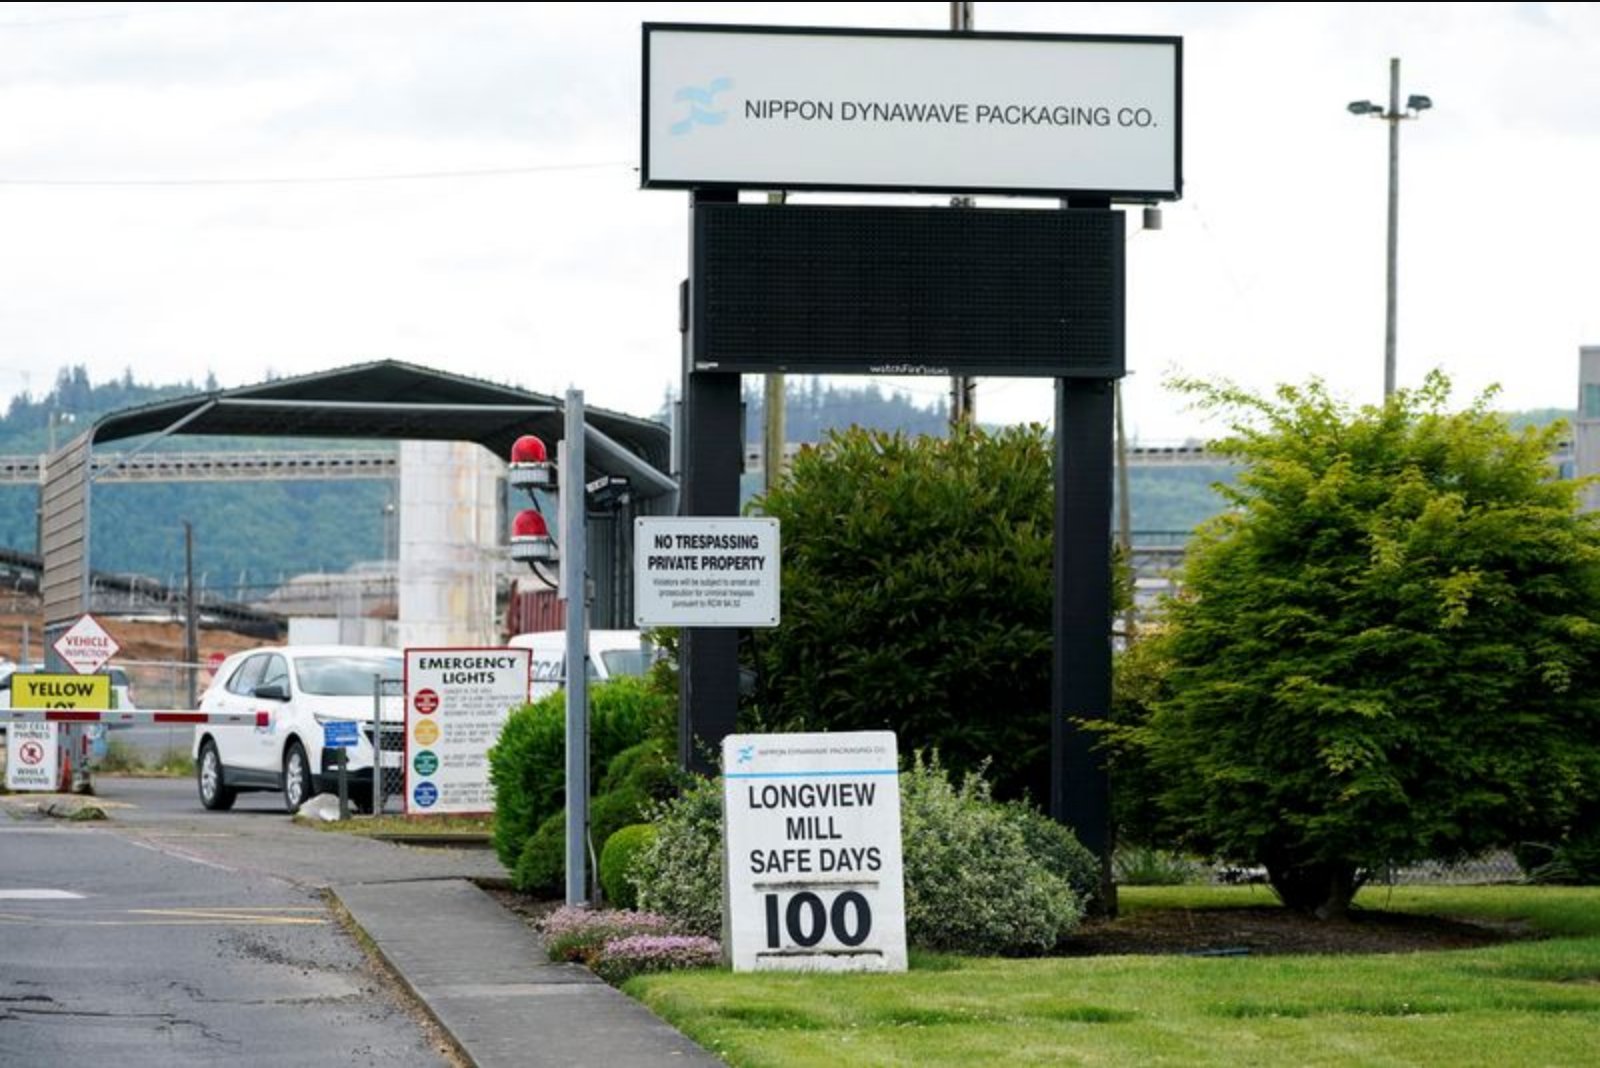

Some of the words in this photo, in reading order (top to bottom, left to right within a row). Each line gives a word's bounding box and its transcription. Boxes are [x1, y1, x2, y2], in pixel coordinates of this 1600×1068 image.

[745, 99, 833, 121] NIPPON
[841, 101, 969, 124] DYNAWAVE
[975, 104, 1111, 127] PACKAGING
[1117, 107, 1158, 128] CO.
[654, 534, 673, 550] NO
[676, 534, 759, 550] TRESPASSING
[648, 555, 698, 571] PRIVATE
[701, 555, 765, 571] PROPERTY
[65, 637, 109, 647] VEHICLE
[419, 657, 516, 670] EMERGENCY
[442, 671, 495, 684] LIGHTS
[28, 682, 94, 697] YELLOW
[749, 783, 876, 809] LONGVIEW
[786, 815, 843, 841] MILL
[750, 849, 812, 874] SAFE
[819, 847, 882, 872] DAYS
[765, 890, 872, 948] 100
